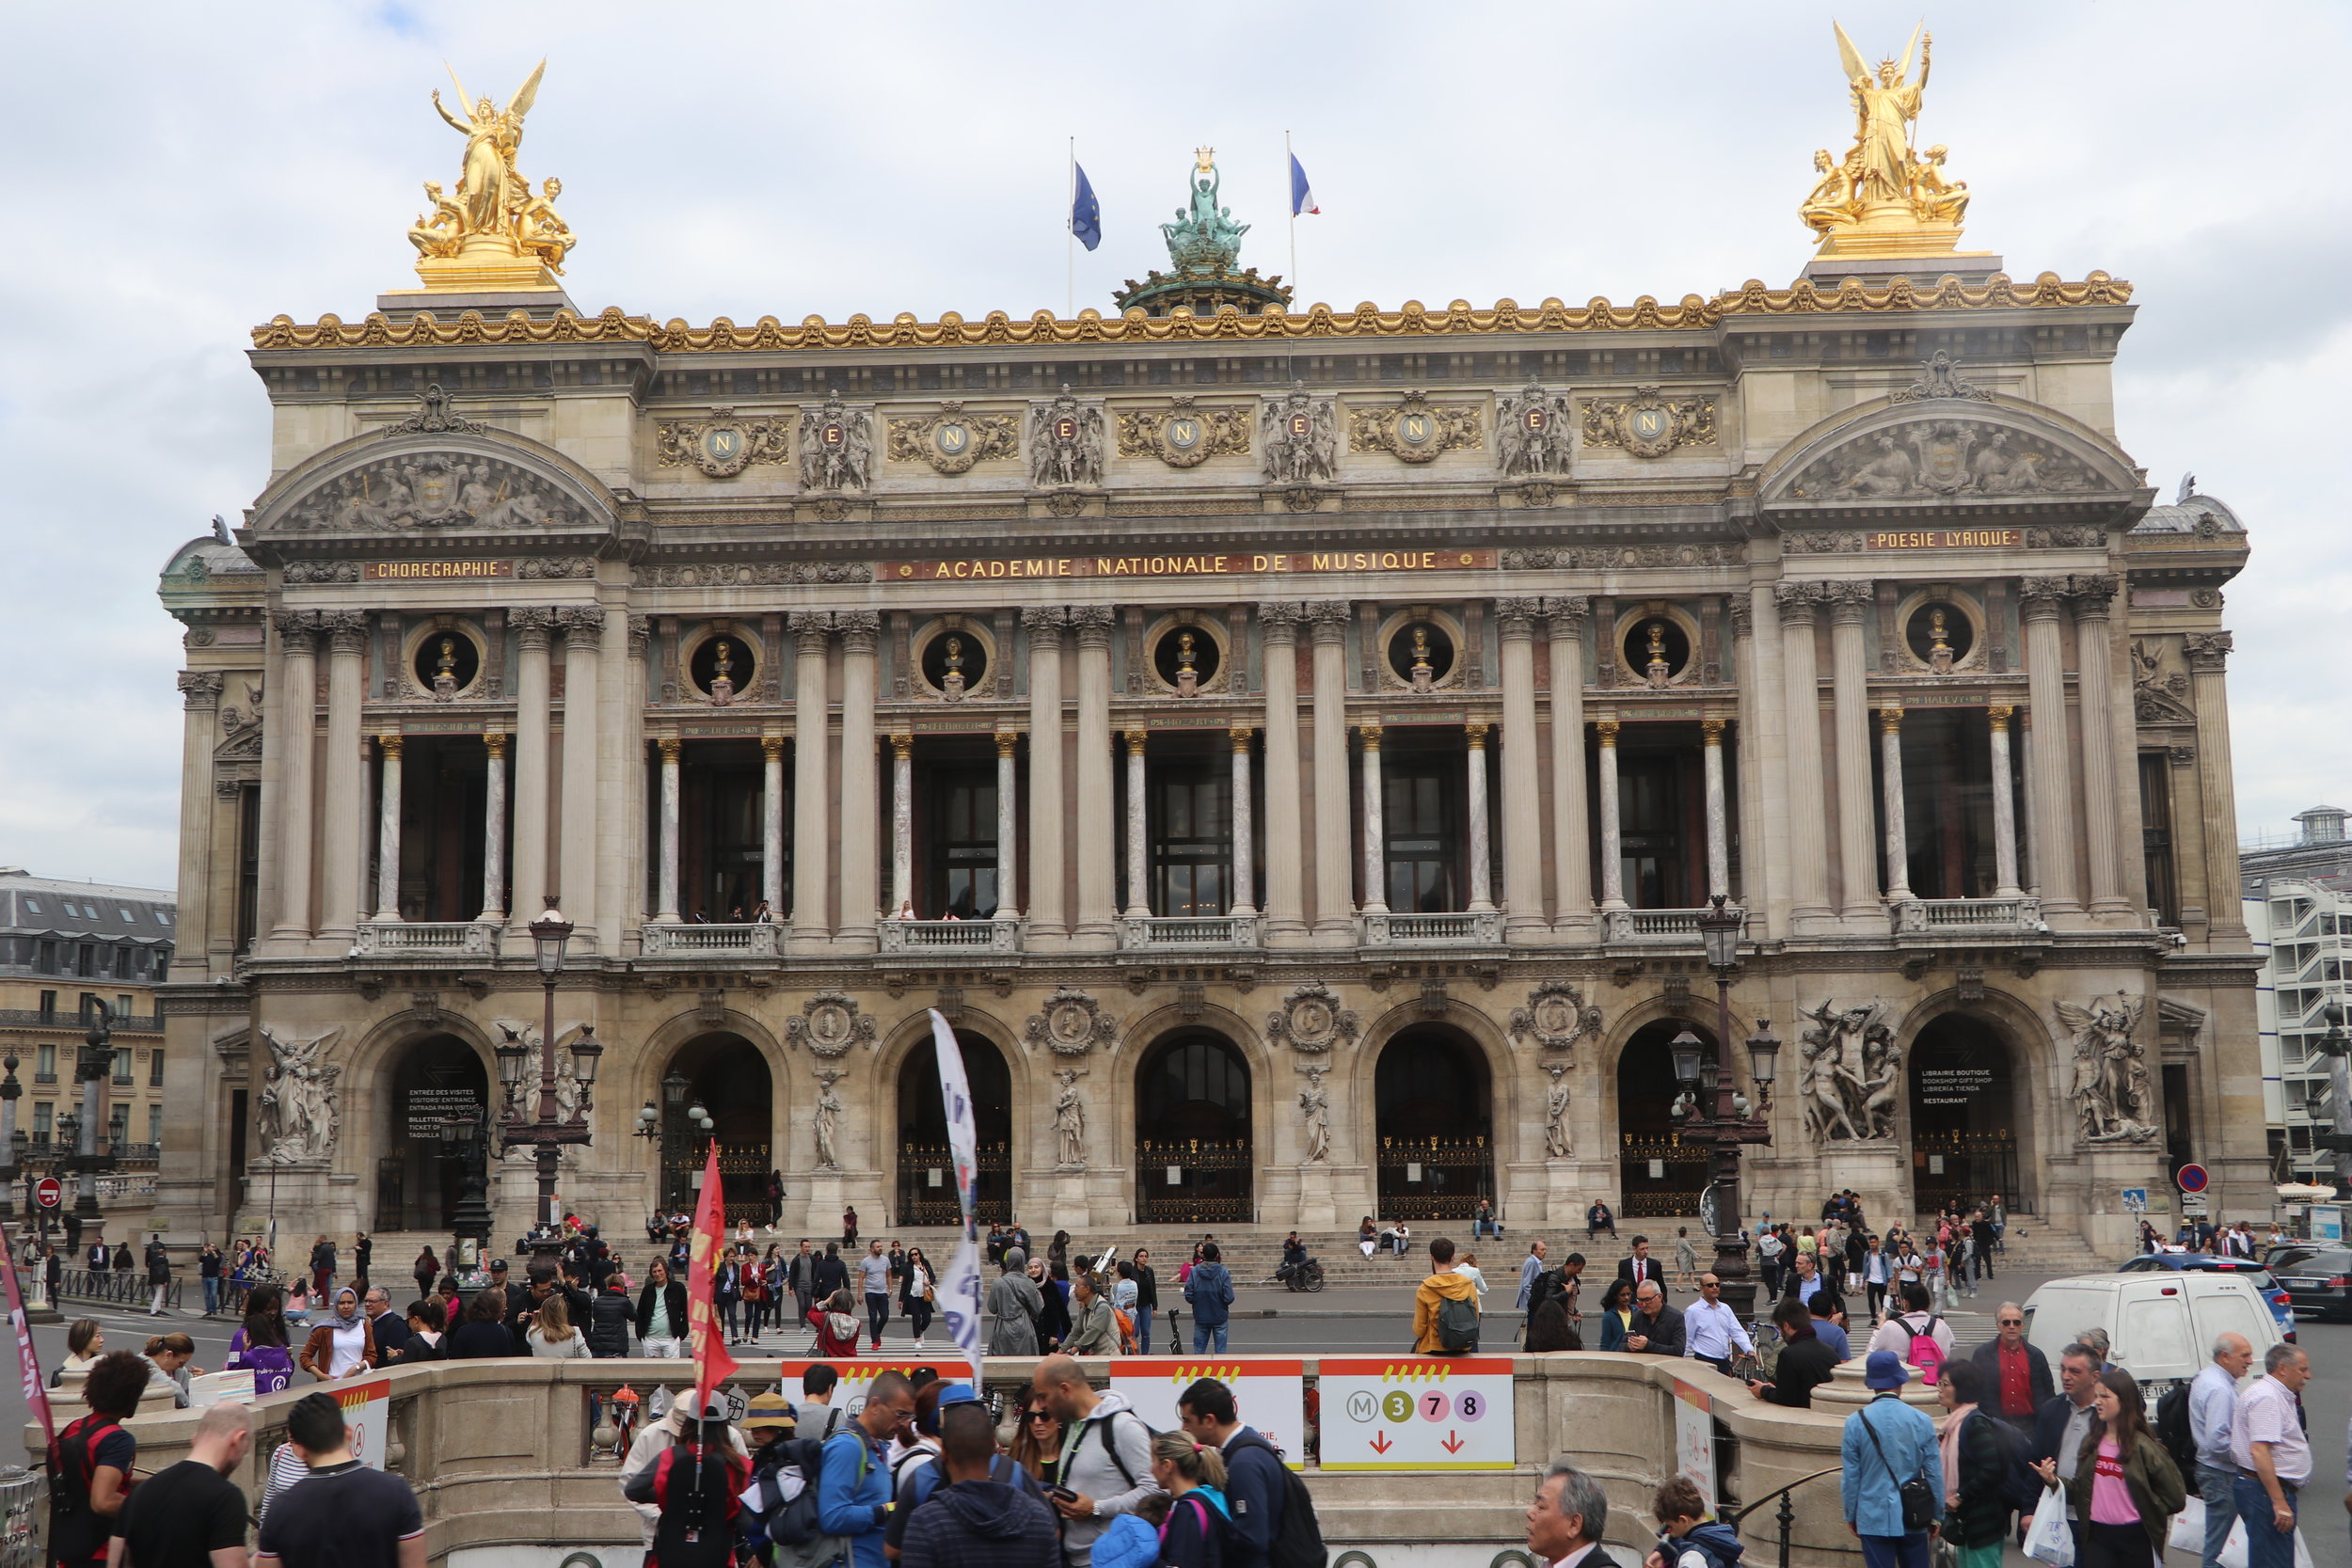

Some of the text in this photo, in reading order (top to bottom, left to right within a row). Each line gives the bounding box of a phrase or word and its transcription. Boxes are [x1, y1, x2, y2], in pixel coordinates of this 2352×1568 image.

[1295, 418, 1304, 433] E
[1530, 414, 1540, 428] E
[1642, 416, 1656, 430] N
[828, 429, 837, 443] E
[1061, 423, 1070, 436] E
[1177, 425, 1190, 439] N
[1409, 422, 1422, 436] N
[715, 436, 729, 451] N
[946, 432, 960, 446] N
[1878, 531, 2010, 547] POESIE LYRIQUE
[378, 562, 499, 577] CHOREGRAPHIE
[936, 552, 1435, 578] ACADEMIE NATIONALE DE MUSIQUE
[1355, 1398, 1476, 1417] M 3 7 8
